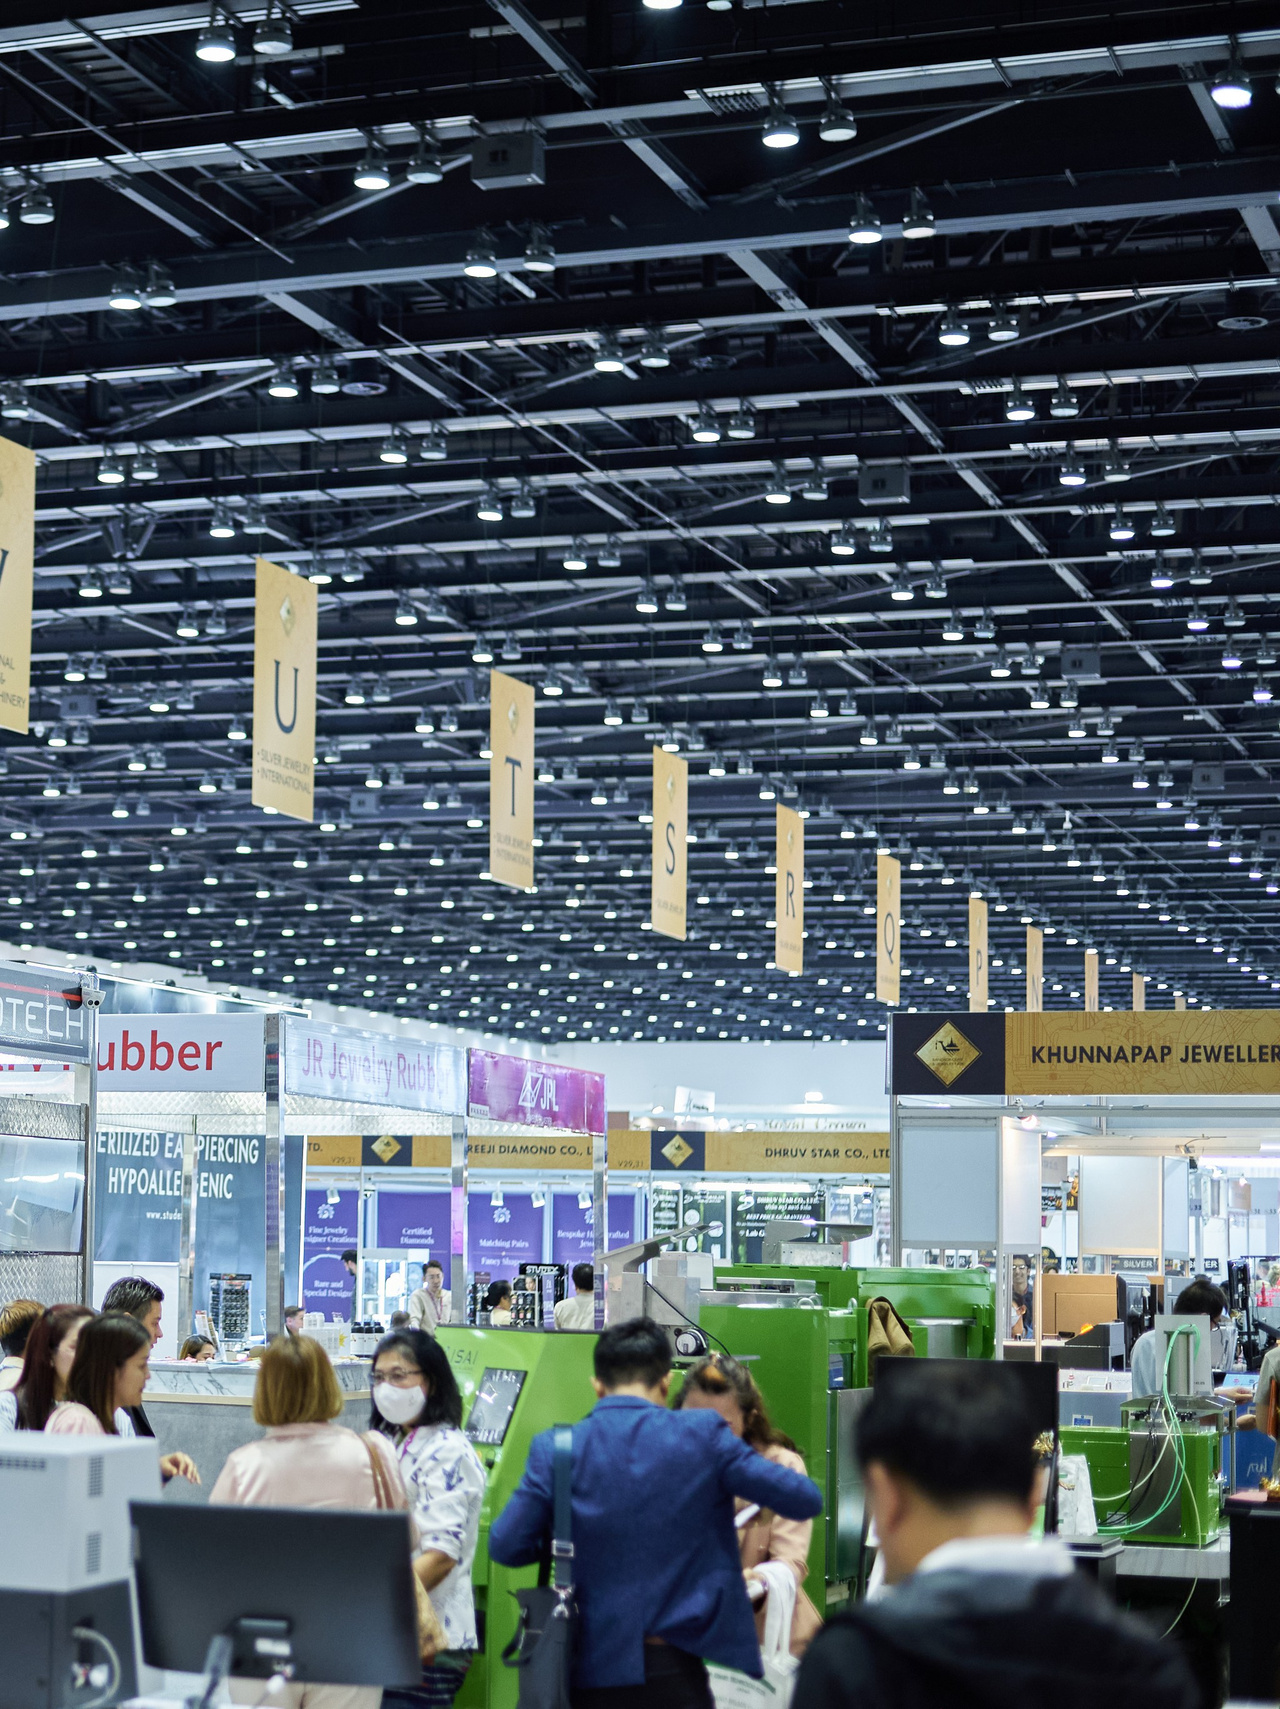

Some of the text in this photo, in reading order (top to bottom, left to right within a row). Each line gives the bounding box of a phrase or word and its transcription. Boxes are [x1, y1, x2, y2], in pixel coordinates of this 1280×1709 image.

[0, 672, 6, 685] &
[274, 659, 299, 734] U
[260, 748, 310, 777] SILVER JEWELRY
[260, 767, 311, 795] INTERNATIONAL
[505, 756, 522, 816] T
[665, 821, 676, 876] S
[786, 869, 796, 918] R
[884, 911, 895, 965] Q
[976, 949, 983, 987] P
[97, 1029, 223, 1072] ubber
[1032, 1044, 1280, 1064] KHUNNAPAP JEWELLER
[302, 1038, 323, 1078] JR
[329, 1042, 392, 1097] Jewelry
[540, 1077, 559, 1112] JPL
[97, 1132, 259, 1164] ERILIZED EA PIERCING
[466, 1145, 495, 1154] REEJI
[499, 1145, 556, 1155] DIAMOND
[560, 1146, 582, 1156] CO.,
[765, 1148, 807, 1158] DHRUV
[811, 1148, 839, 1158] STAR
[845, 1148, 868, 1160] CO.,
[108, 1167, 233, 1199] HYPOALLEENIC
[146, 1209, 182, 1220] www.stude
[304, 1235, 326, 1243] signer
[308, 1226, 348, 1235] Fine Jewelry
[400, 1236, 434, 1244] Diamonds
[402, 1227, 433, 1235] Certified
[557, 1230, 585, 1239] Bespoke
[479, 1239, 529, 1248] Matching Pairs
[481, 1257, 502, 1266] Fancy
[1123, 1259, 1153, 1268] SILVER
[304, 1290, 327, 1298] Special
